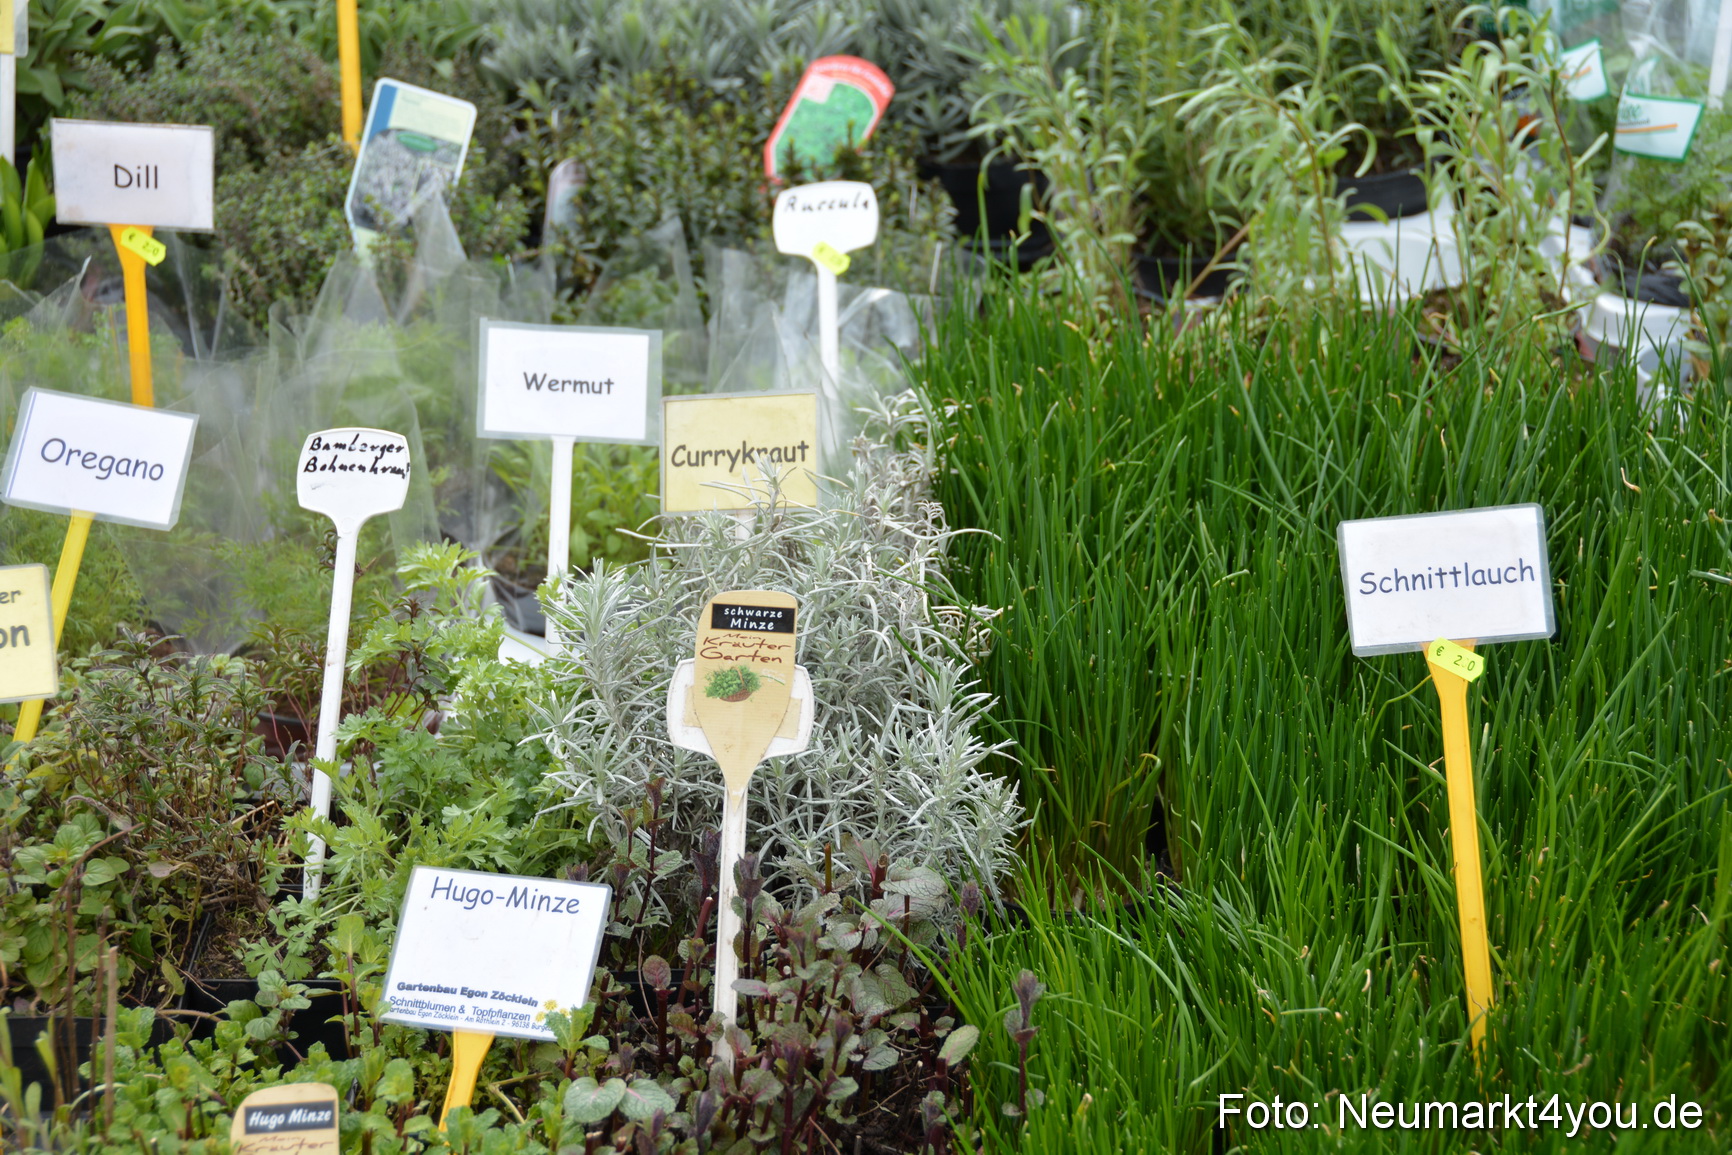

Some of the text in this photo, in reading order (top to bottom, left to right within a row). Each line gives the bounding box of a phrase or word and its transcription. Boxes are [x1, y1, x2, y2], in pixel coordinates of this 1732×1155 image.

[114, 164, 158, 190] Dill
[523, 371, 615, 395] Wermut
[40, 438, 164, 481] Oregano
[671, 440, 810, 473] Currykraut
[1359, 557, 1536, 595] Schnittlauch
[724, 607, 783, 619] schwarze
[730, 618, 774, 630] Minze
[700, 646, 782, 664] Garten
[703, 636, 792, 650] Kräuter
[1435, 645, 1446, 657] €
[430, 876, 581, 915] Hugo-Minze
[397, 981, 539, 1008] Gartenbau Egon Zöcklein
[389, 995, 531, 1022] Schnittblumen & Topfpflanzen
[389, 1006, 417, 1016] artenbau
[417, 1009, 432, 1018] Egon
[249, 1107, 332, 1130] Hugo Minze
